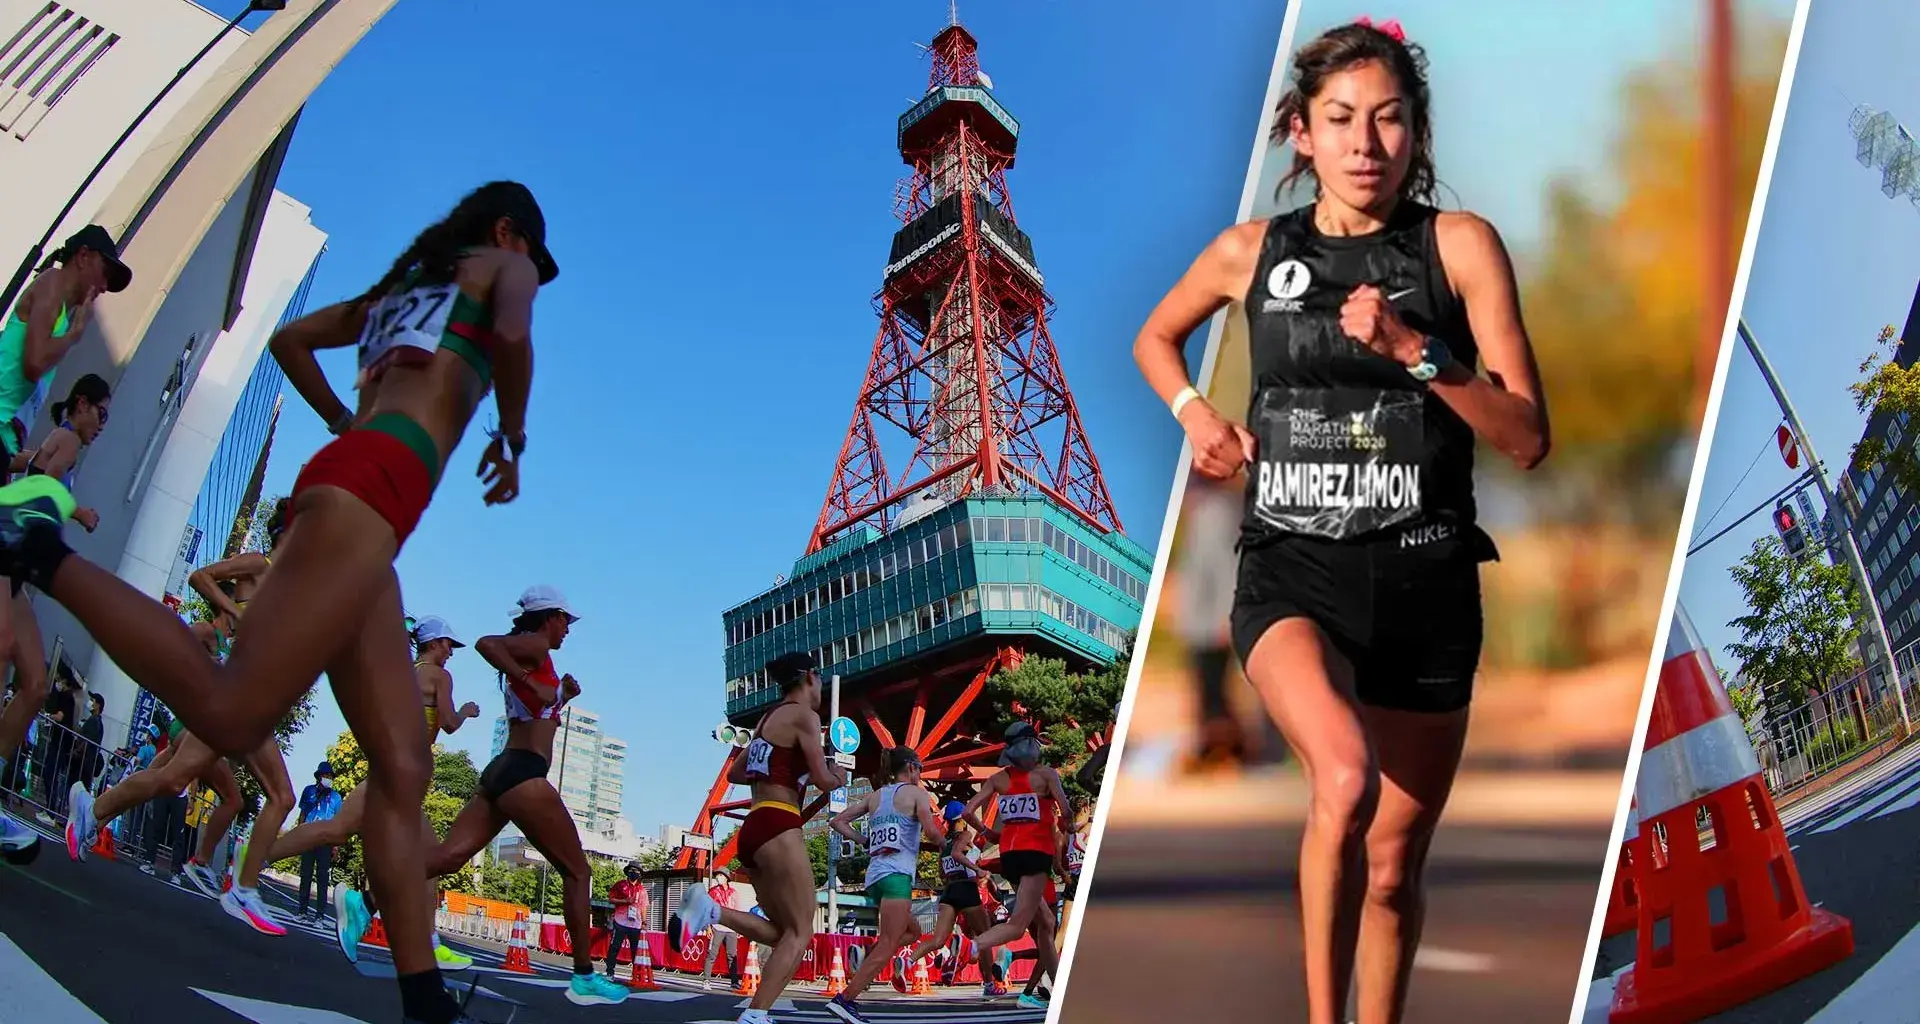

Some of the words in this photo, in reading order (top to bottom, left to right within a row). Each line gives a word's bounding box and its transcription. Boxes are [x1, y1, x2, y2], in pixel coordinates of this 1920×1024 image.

[883, 221, 961, 280] Panasonic
[980, 219, 1045, 285] Panasonic
[1290, 436, 1350, 449] PROJECT
[1354, 435, 1387, 449] 2020
[1258, 461, 1349, 507] RAMIREZ
[1400, 523, 1450, 549] NIKE
[999, 796, 1037, 814] 2673
